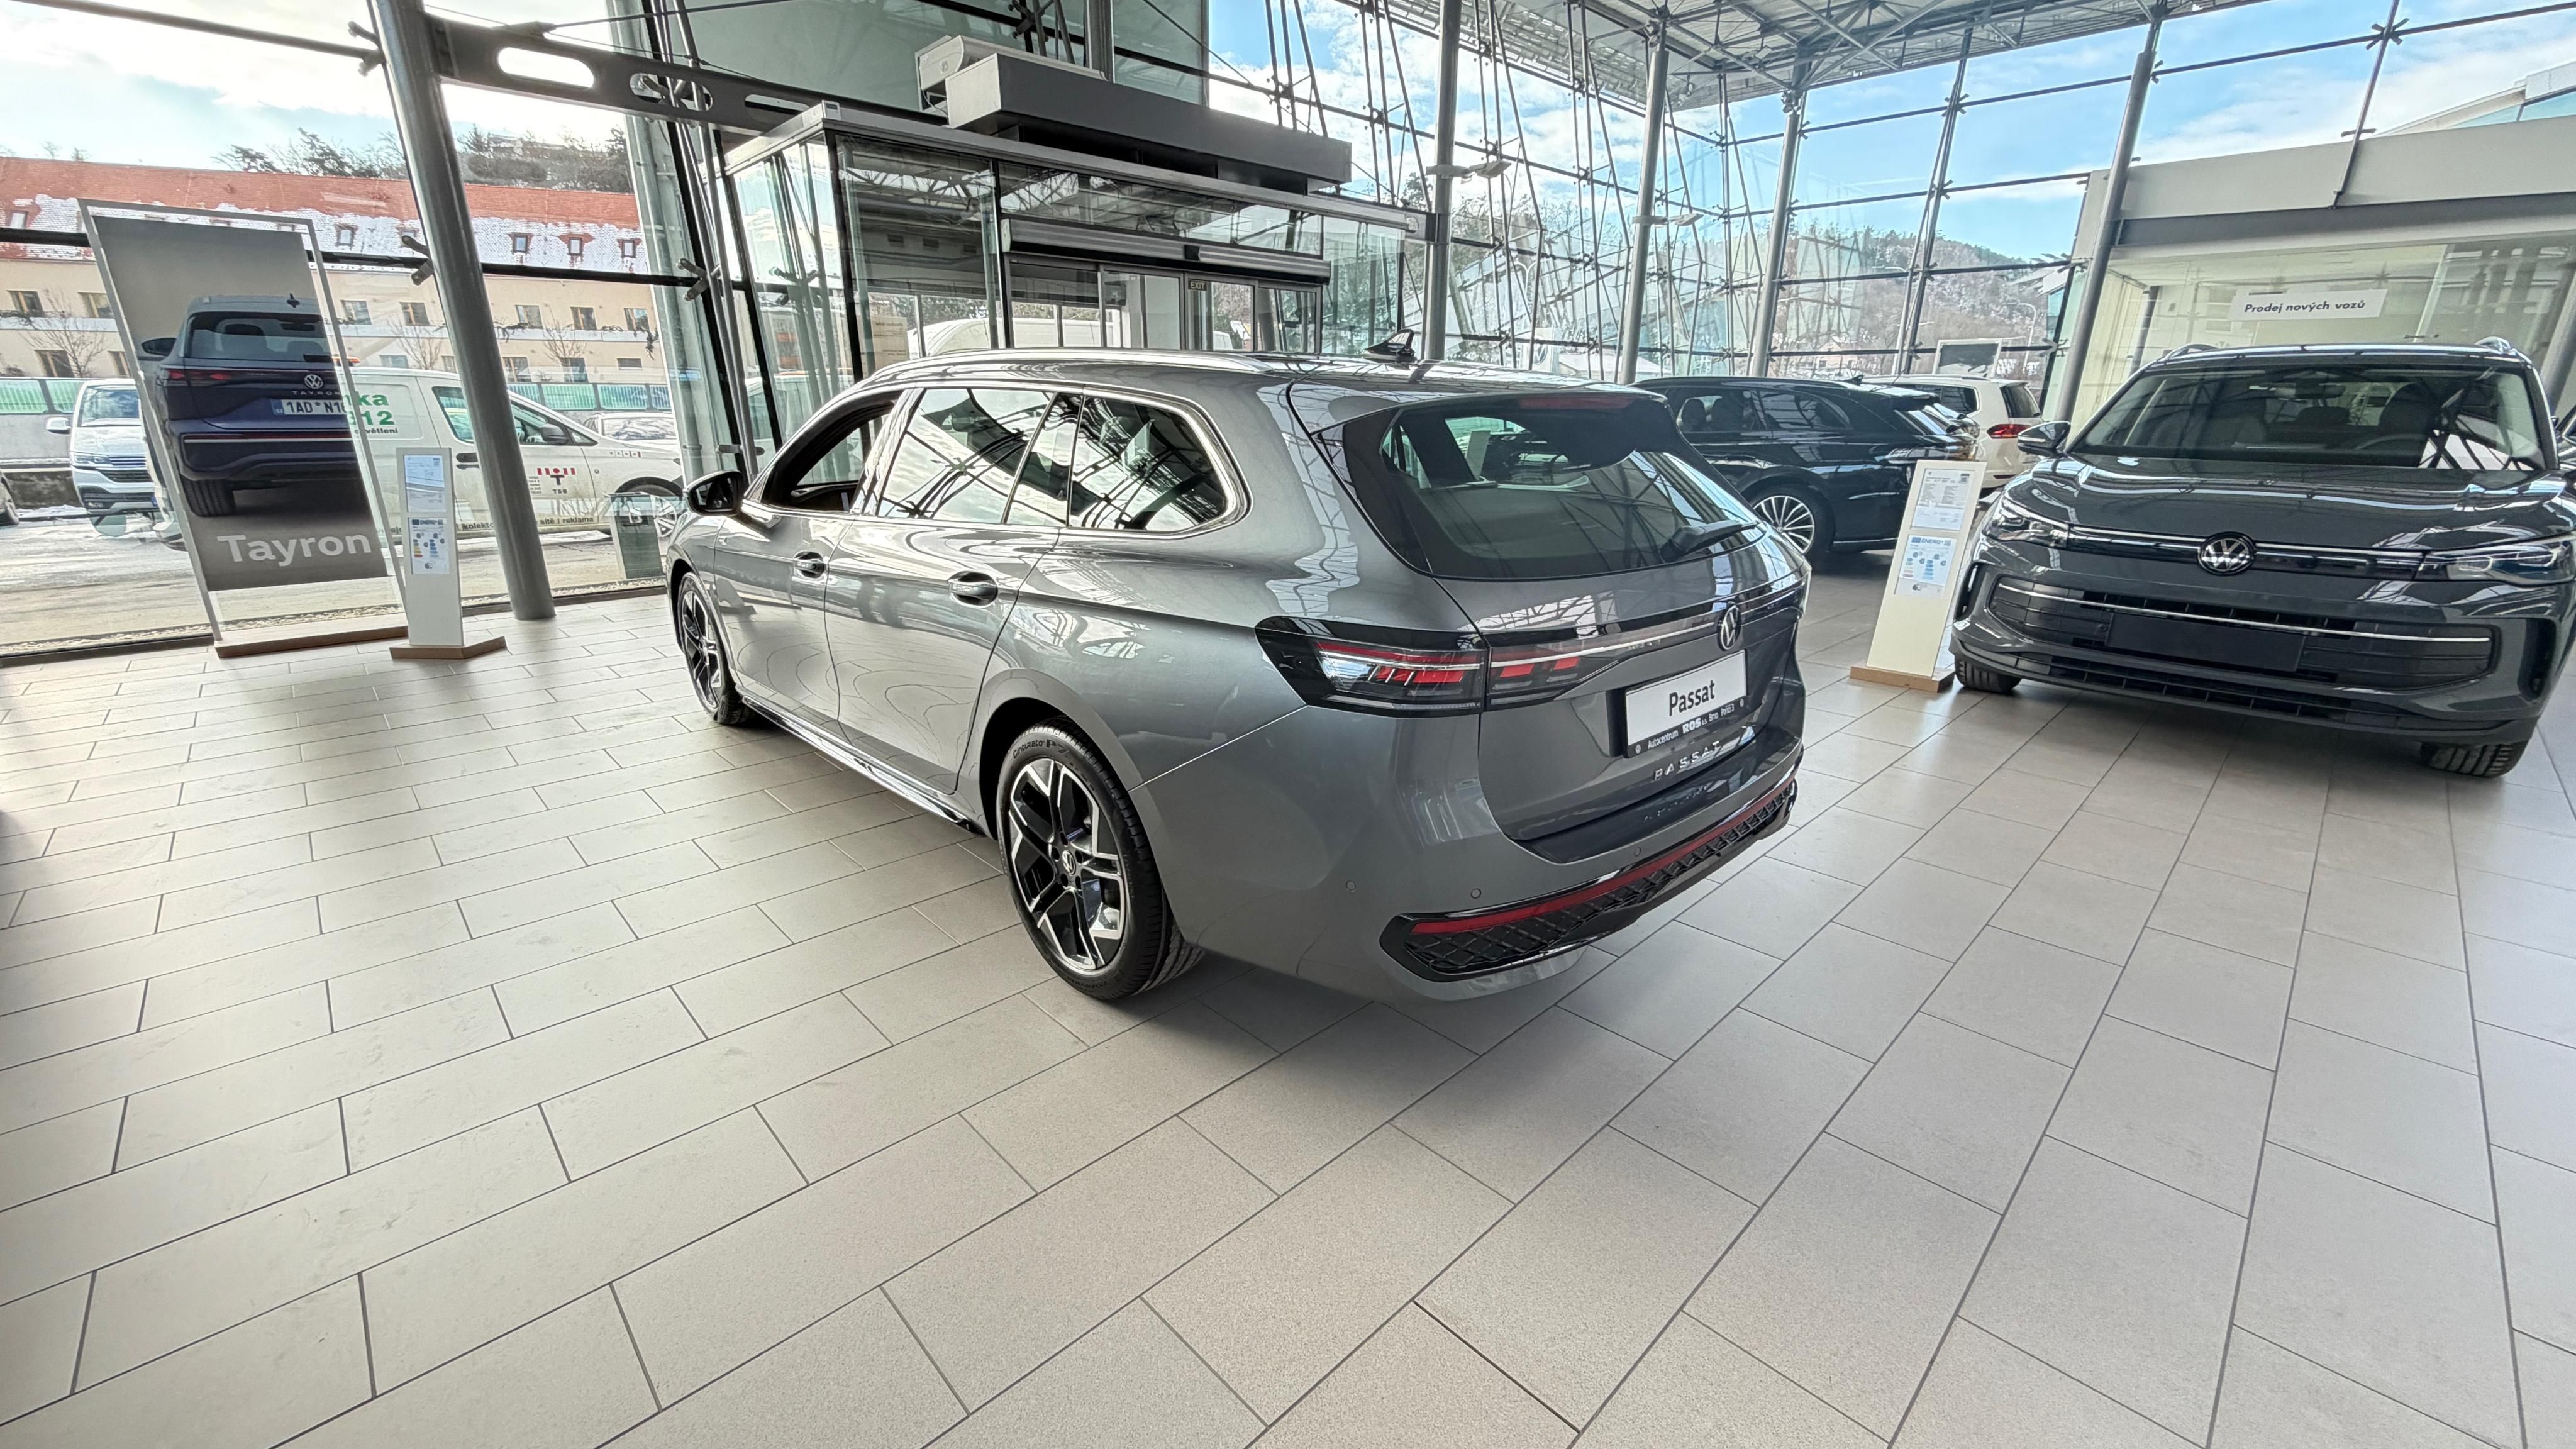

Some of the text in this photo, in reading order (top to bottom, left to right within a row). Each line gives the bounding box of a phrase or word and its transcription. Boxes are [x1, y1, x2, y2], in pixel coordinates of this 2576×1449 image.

[2244, 300, 2365, 313] Prodej nových vozů
[216, 535, 372, 567] Tayron
[1668, 680, 1715, 716] Passat
[1648, 730, 1679, 749] Autocentrum
[1682, 718, 1701, 734] ROS
[1709, 712, 1719, 722] Brno
[1654, 741, 1719, 780] PASSAT
